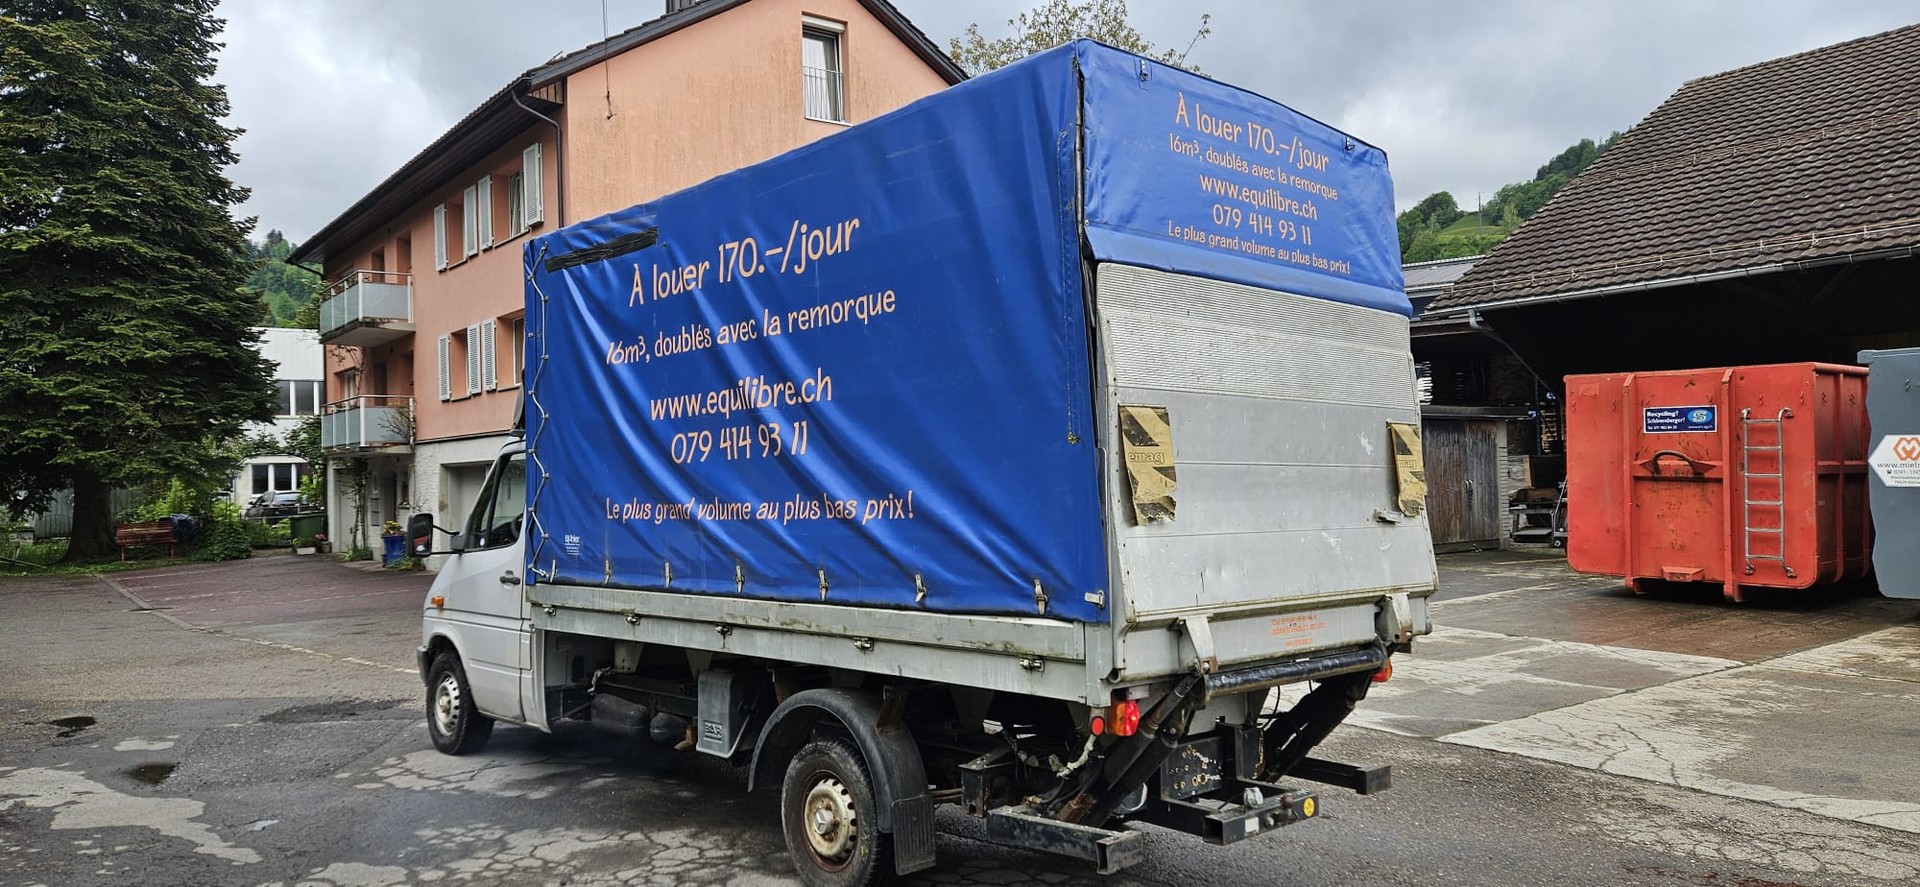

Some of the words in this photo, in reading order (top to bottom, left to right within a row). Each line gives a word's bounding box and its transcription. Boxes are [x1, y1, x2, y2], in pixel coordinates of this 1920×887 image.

[1176, 91, 1190, 128] À
[1196, 103, 1242, 143] louer
[1248, 122, 1329, 172] 170.-/jour
[1200, 174, 1317, 220] www.equilibre.ch
[1206, 146, 1249, 173] doublés
[1252, 164, 1275, 180] avec
[1278, 166, 1287, 184] la
[1290, 175, 1338, 200] remorque
[1168, 220, 1181, 237] Le
[1184, 225, 1206, 242] plus
[1208, 233, 1238, 250] grand
[1242, 239, 1276, 258] volume
[1278, 248, 1289, 260] au
[1292, 251, 1311, 266] plus
[1312, 254, 1328, 269] bas
[1330, 260, 1350, 274] prix!
[1213, 203, 1242, 229] 079
[1249, 212, 1273, 236] 414
[1278, 220, 1297, 241] 93
[1301, 225, 1312, 245] 11
[629, 263, 644, 307] À
[653, 259, 710, 300] louer
[718, 217, 860, 283] 170.-/jour
[654, 324, 712, 358] doublés
[716, 319, 757, 345] avec
[763, 308, 781, 337] la
[788, 289, 896, 333] remorque
[650, 367, 833, 421] www.equilibre.ch
[671, 430, 712, 464] 079
[720, 425, 752, 461] 414
[758, 422, 781, 458] 93
[791, 420, 808, 456] 11
[1397, 459, 1416, 469] mag
[606, 498, 620, 519] Le
[623, 497, 651, 524] plus
[655, 496, 696, 525] grand
[697, 497, 751, 521] volume
[756, 501, 780, 520] au
[783, 493, 821, 526] plus
[823, 493, 857, 518] bas
[863, 490, 913, 525] prix!
